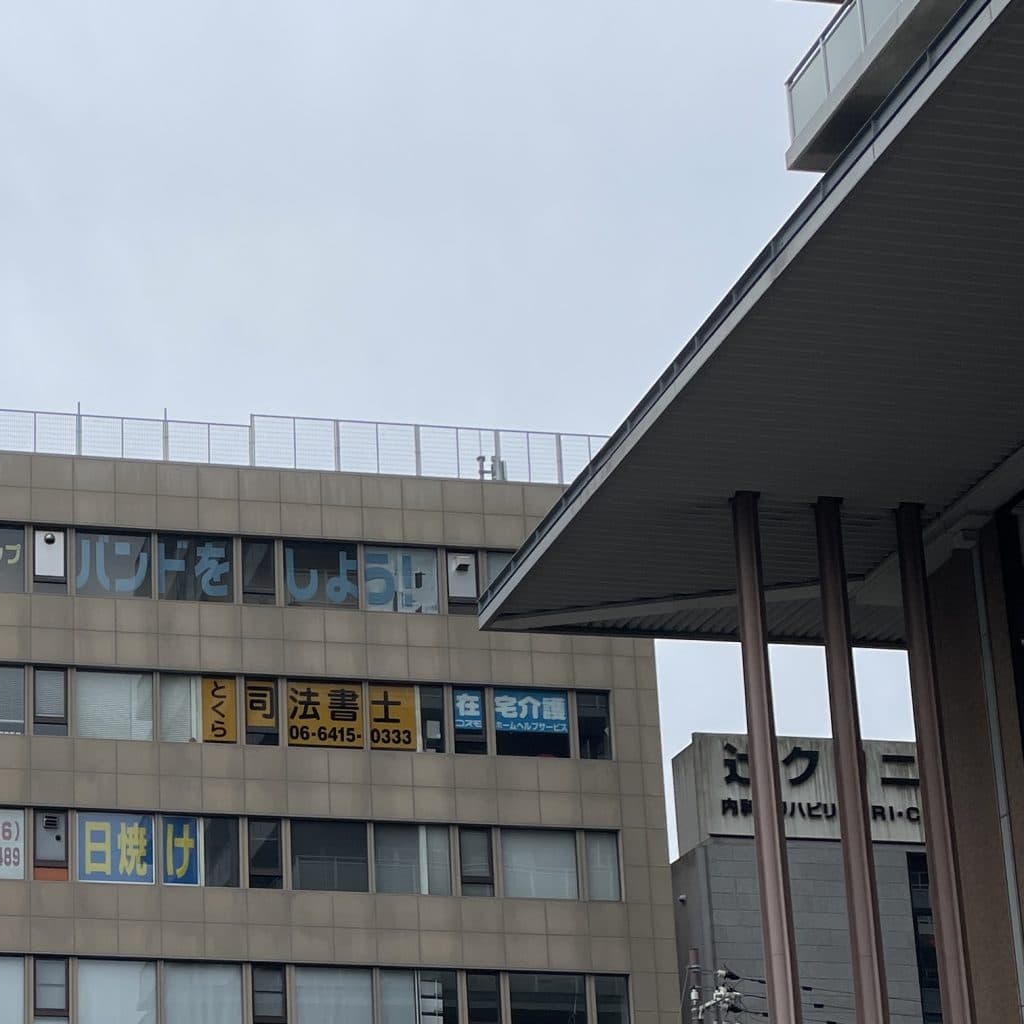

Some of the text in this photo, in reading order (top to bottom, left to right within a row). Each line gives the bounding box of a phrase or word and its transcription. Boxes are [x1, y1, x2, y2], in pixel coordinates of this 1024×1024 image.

[210, 681, 228, 738] とくら
[247, 685, 401, 723] 司法書士
[456, 693, 567, 720] 在宅介護
[84, 821, 195, 879] 日焼け
